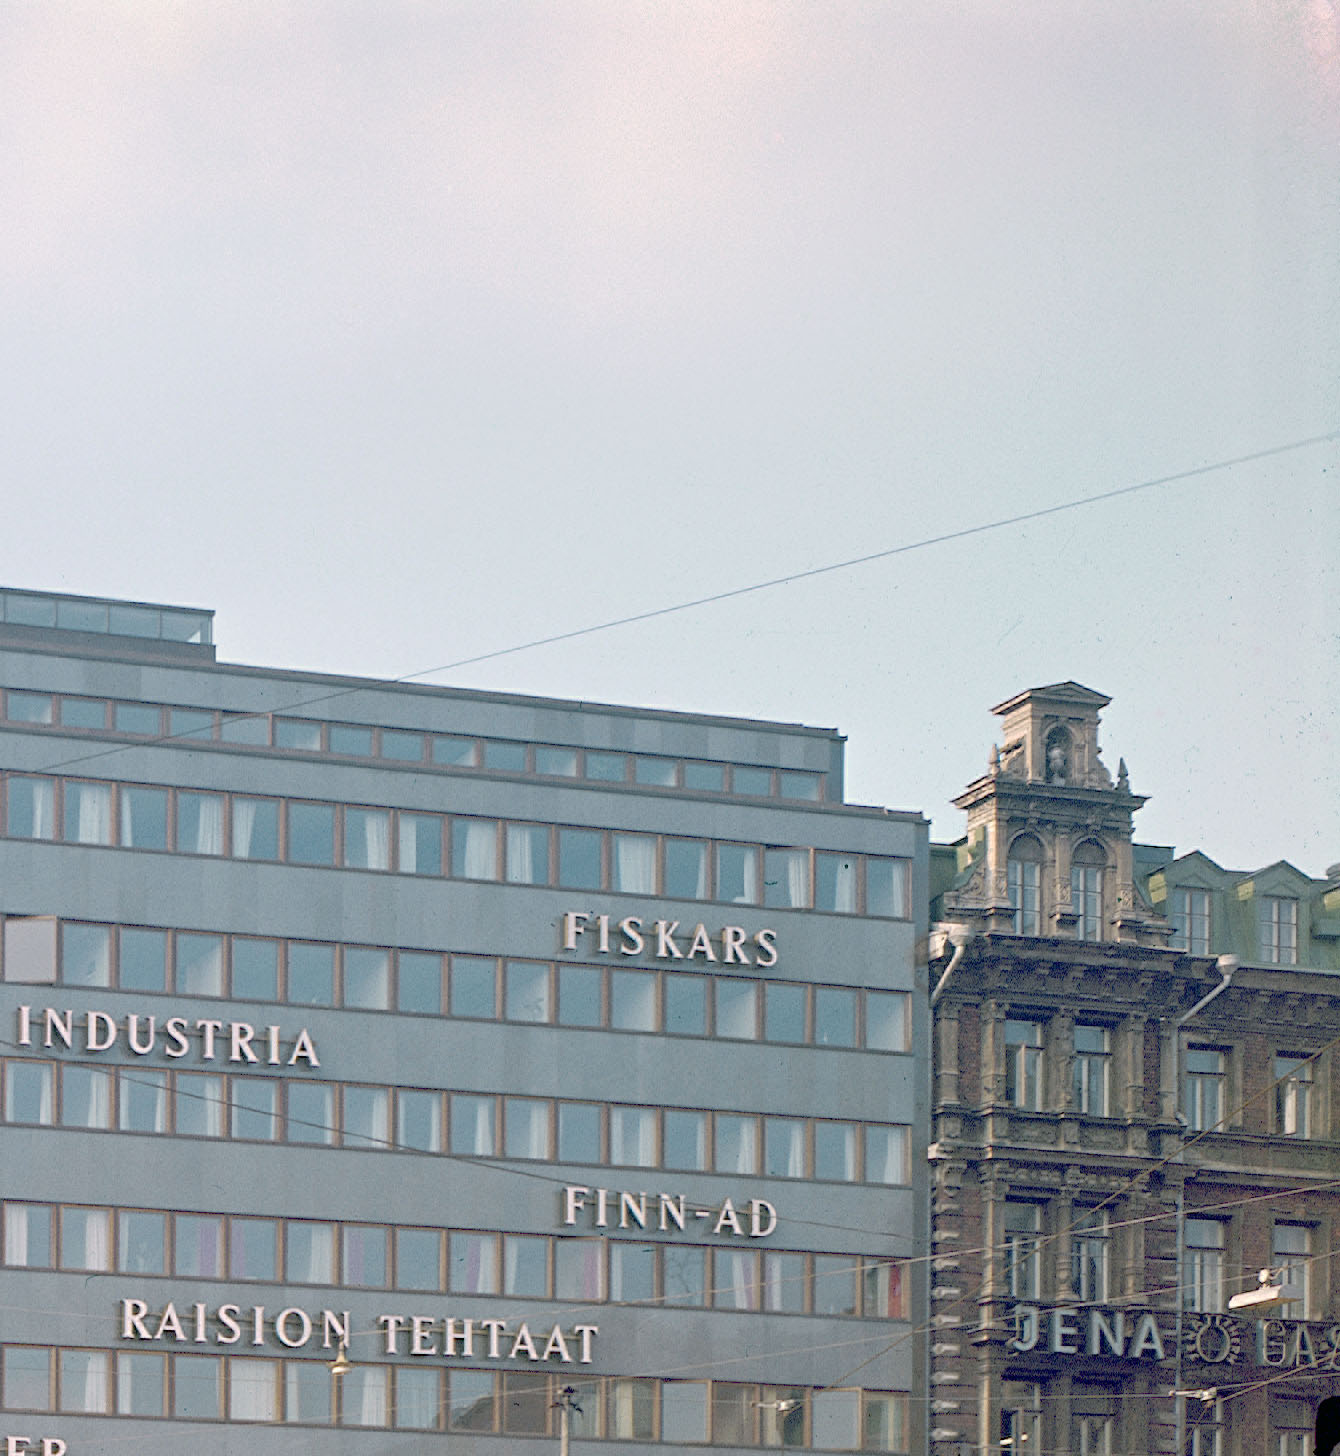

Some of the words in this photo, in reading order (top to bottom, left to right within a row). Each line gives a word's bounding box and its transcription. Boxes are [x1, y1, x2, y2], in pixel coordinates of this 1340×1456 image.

[563, 911, 778, 967] FISKARS
[18, 1005, 320, 1068] INDUSTRIA
[563, 1186, 777, 1237] FINN-AD
[121, 1299, 351, 1349] RAISION
[381, 1314, 599, 1364] TEHTAAT
[1010, 1303, 1164, 1360] JENA
